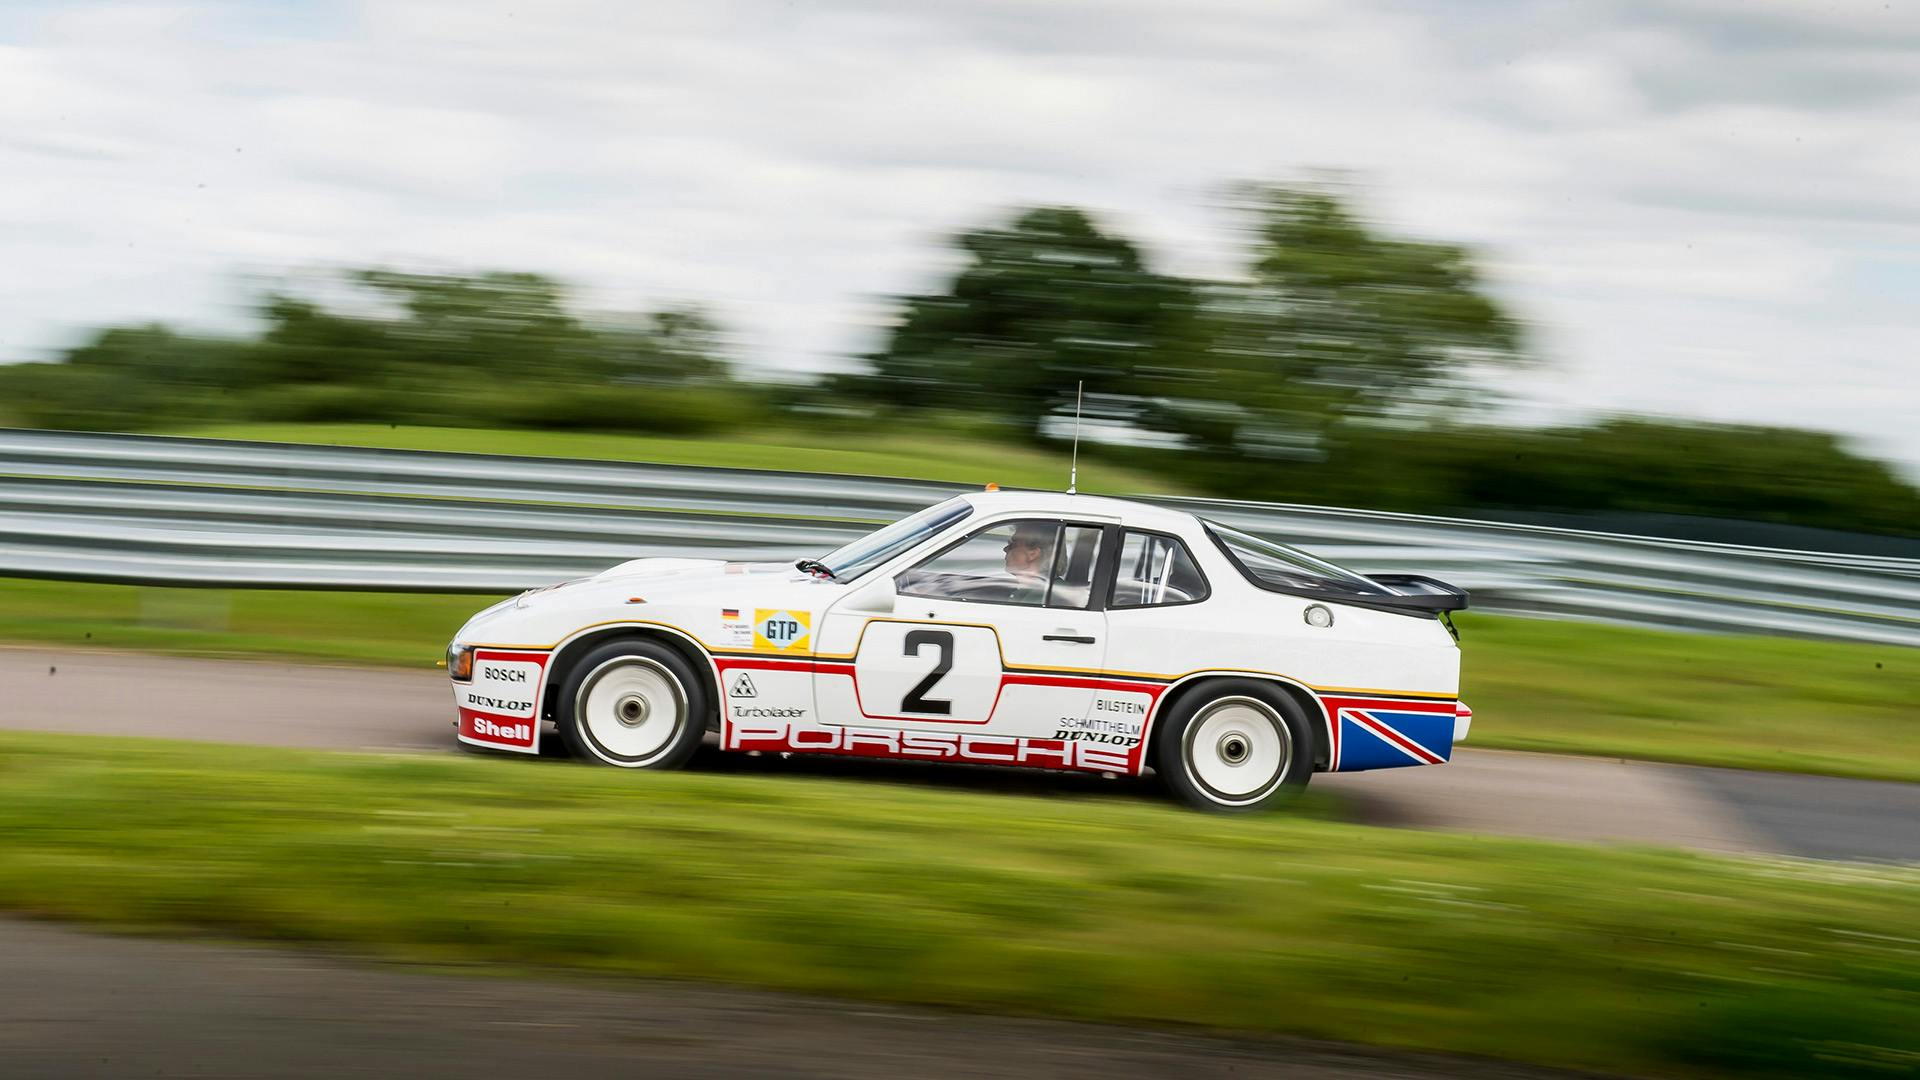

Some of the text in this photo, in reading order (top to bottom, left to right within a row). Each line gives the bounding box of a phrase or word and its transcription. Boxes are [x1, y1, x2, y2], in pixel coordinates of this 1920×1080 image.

[766, 620, 798, 640] GTP
[485, 666, 526, 682] BOSCH
[901, 629, 954, 715] 2
[468, 693, 533, 711] DUNLOP
[1096, 699, 1145, 714] BILSTEIN
[733, 706, 807, 718] Turbolader
[473, 716, 531, 741] Shell
[1060, 717, 1141, 735] SCHMITTHELM
[729, 722, 1129, 773] PORSCHE
[1052, 730, 1142, 747] DUNLOP
